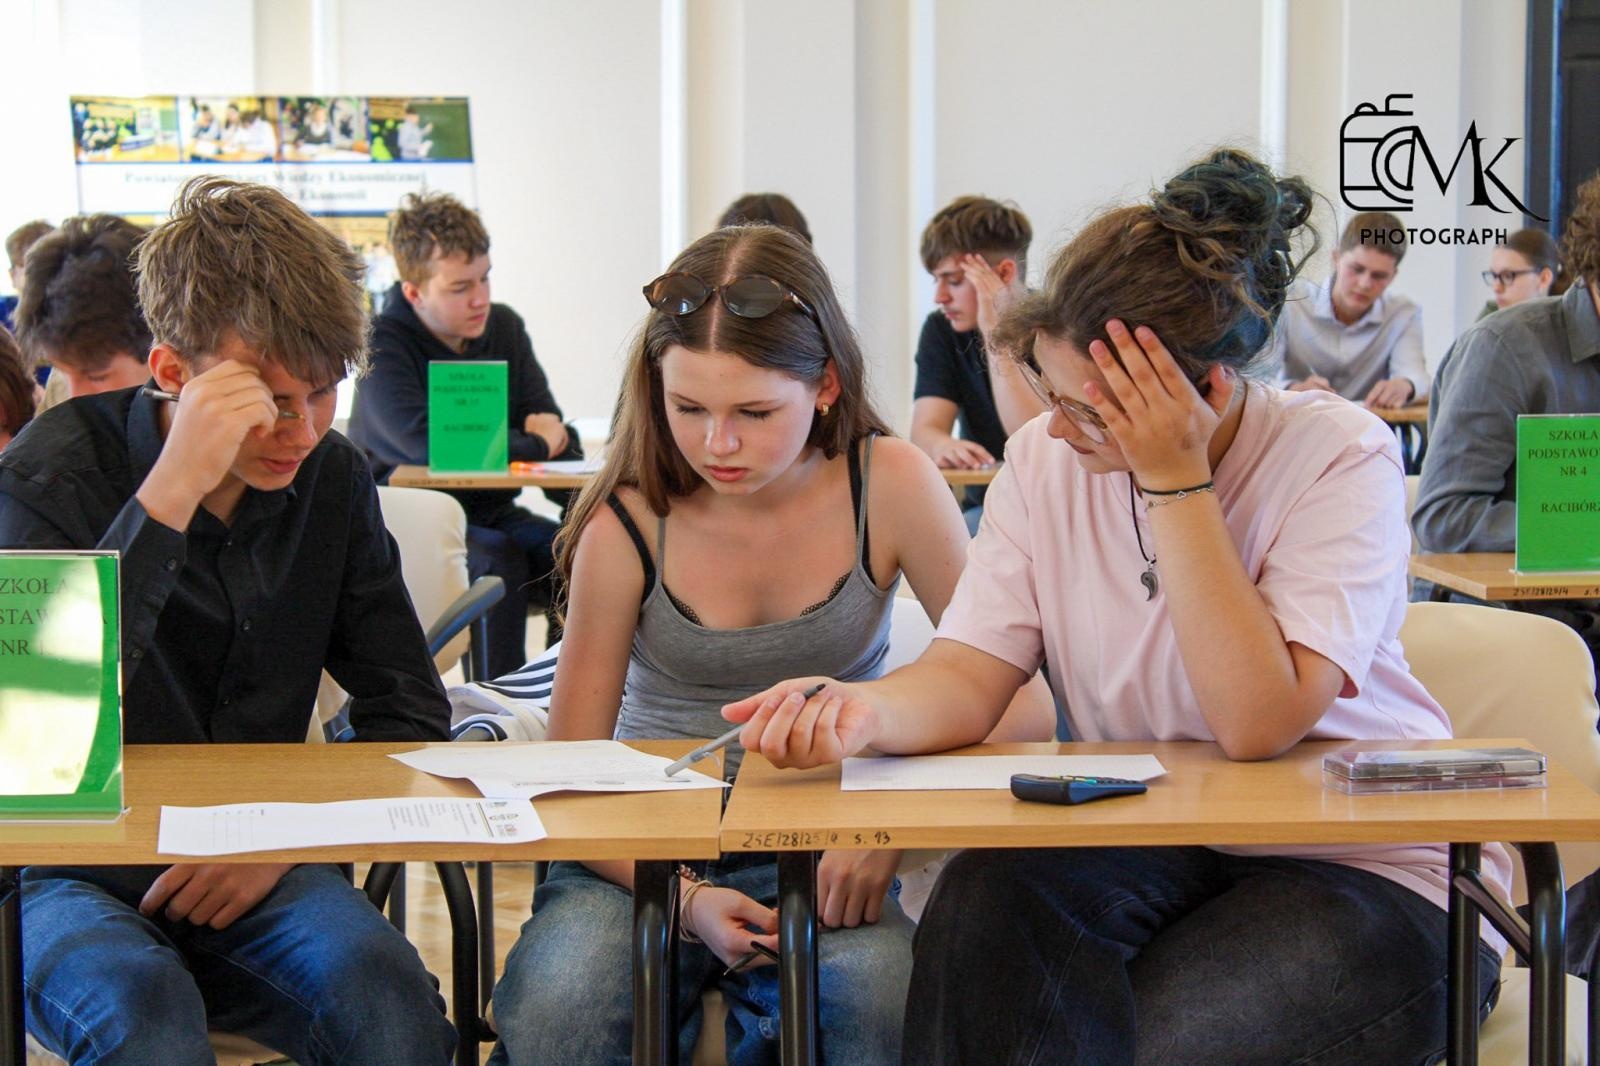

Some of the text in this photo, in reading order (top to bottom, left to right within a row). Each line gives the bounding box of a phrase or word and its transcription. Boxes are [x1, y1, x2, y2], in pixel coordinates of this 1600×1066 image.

[1549, 430, 1599, 441] SZKOŁA
[1528, 447, 1600, 459] PODSTAWO
[1560, 466, 1587, 476] NR 4
[1, 639, 31, 656] NR
